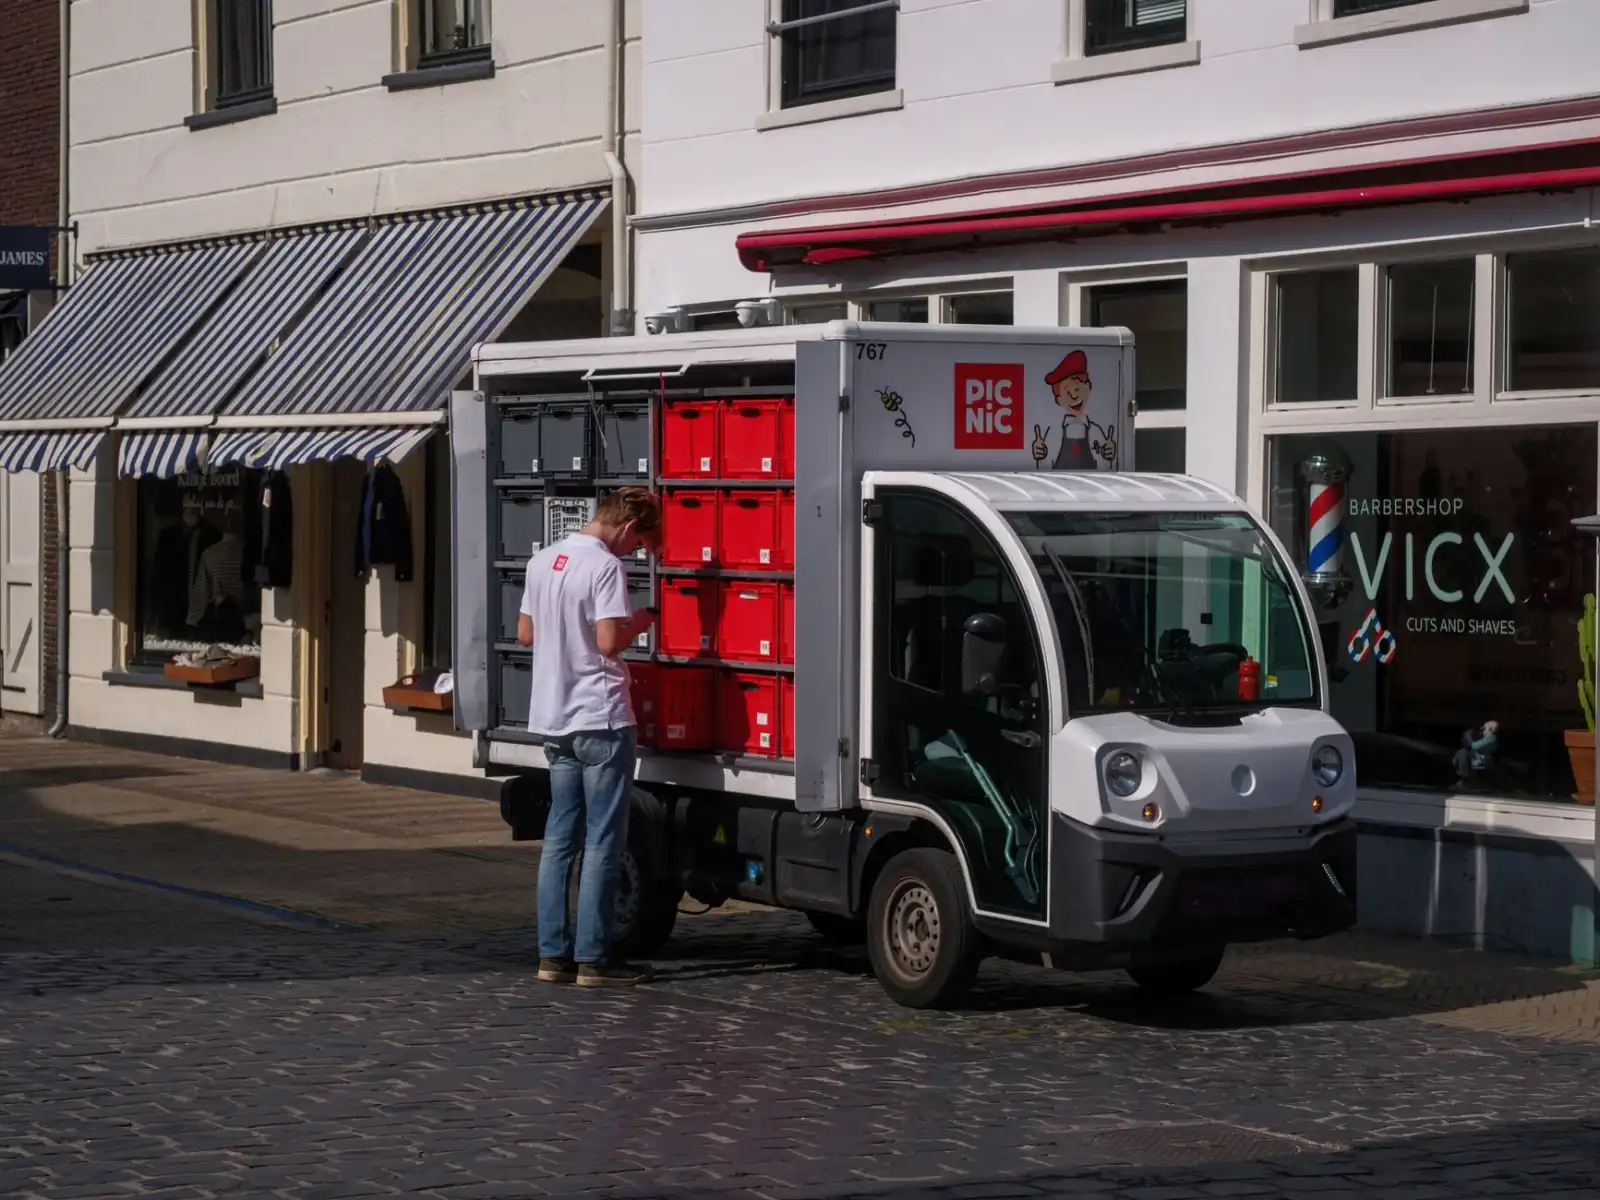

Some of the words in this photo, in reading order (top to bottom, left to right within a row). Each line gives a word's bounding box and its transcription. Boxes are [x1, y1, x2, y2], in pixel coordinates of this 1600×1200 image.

[0, 251, 45, 266] JAMES
[856, 343, 887, 360] 767
[1349, 498, 1463, 516] BARBERSHOP
[1350, 531, 1516, 604] VICX
[1406, 617, 1437, 633] CUTS
[1439, 618, 1465, 633] AND
[1468, 619, 1516, 635] SHAVES
